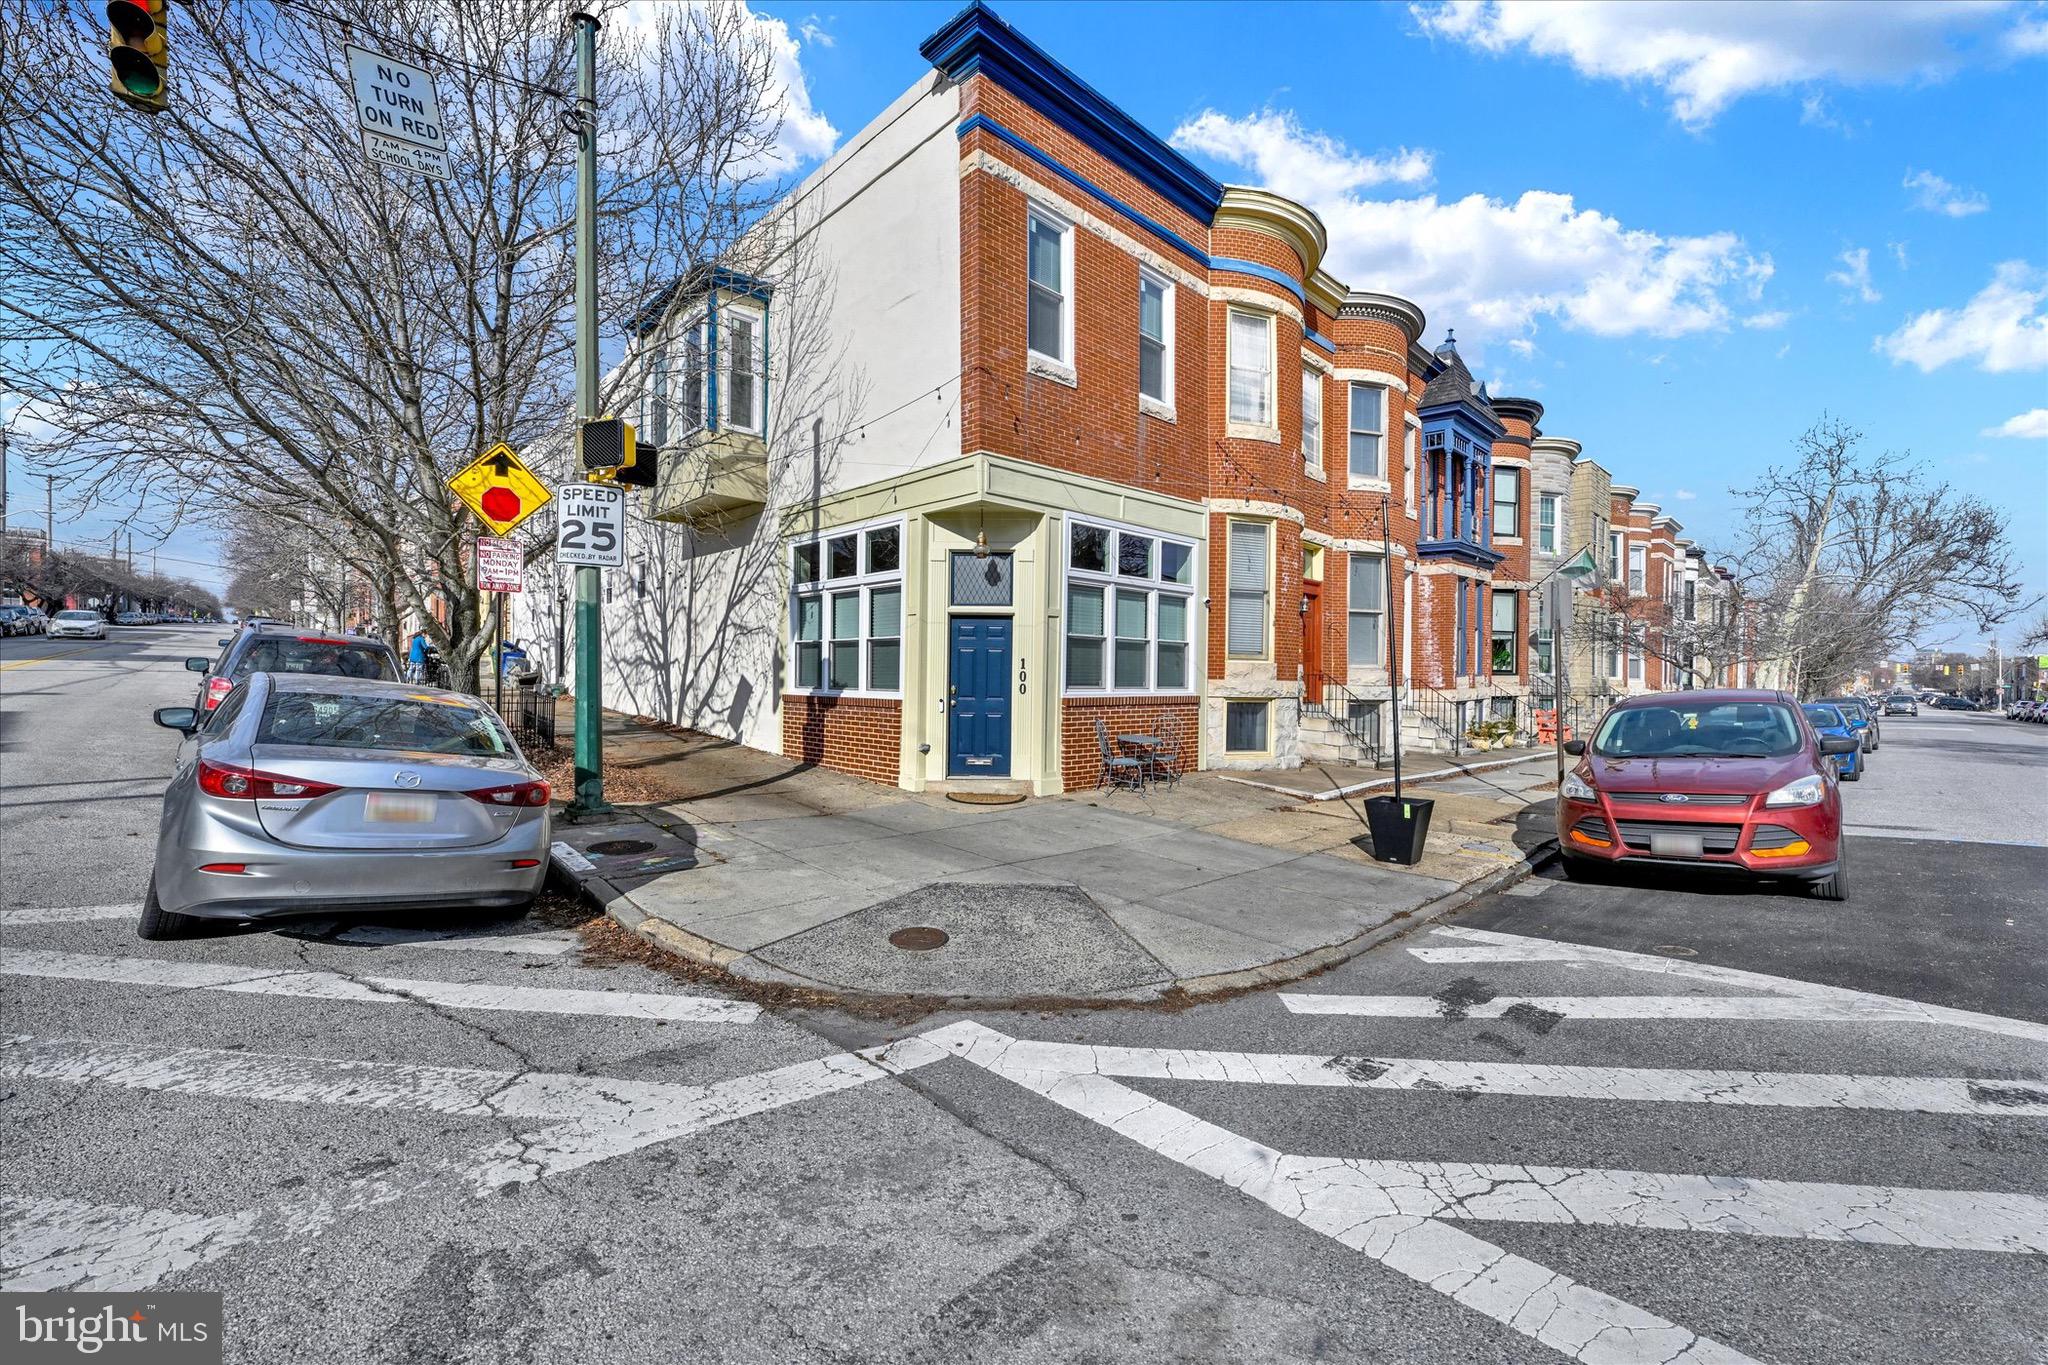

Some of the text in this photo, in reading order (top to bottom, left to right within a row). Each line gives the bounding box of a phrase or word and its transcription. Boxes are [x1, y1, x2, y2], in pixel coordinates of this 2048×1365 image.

[376, 64, 410, 88] NO
[370, 84, 424, 116] TURN
[365, 106, 439, 140] ON RED
[371, 148, 443, 176] SCHOOL DAYS
[562, 488, 618, 503] SPEED
[567, 504, 610, 519] LIMIT
[560, 519, 617, 552] 25
[482, 559, 519, 568] MONDAY
[492, 552, 520, 561] PARKING
[559, 552, 586, 560] CHECKED
[491, 582, 506, 590] AWAY
[507, 583, 520, 591] ZONE
[1019, 657, 1027, 695] 100
